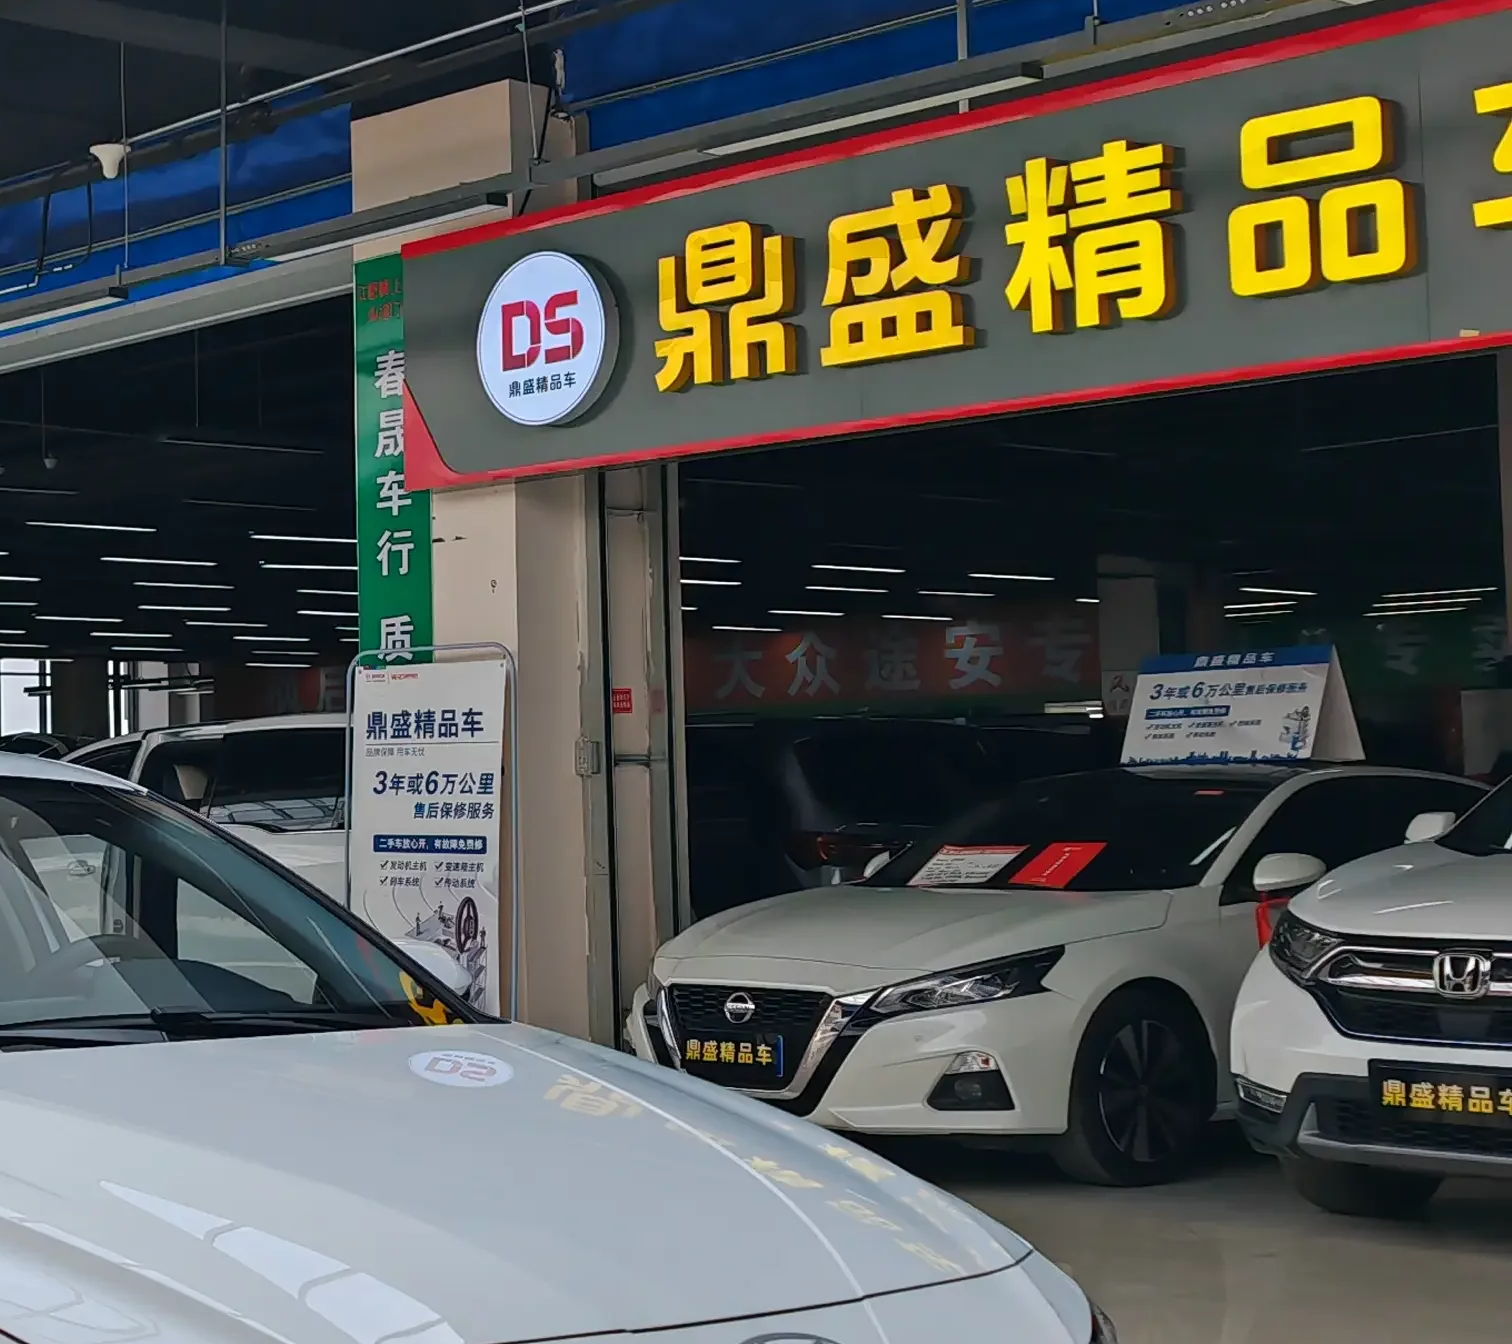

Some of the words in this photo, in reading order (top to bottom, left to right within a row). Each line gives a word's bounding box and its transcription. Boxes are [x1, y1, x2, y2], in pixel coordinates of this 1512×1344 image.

[655, 80, 1512, 395] 鼎盛精品
[501, 289, 584, 372] DS
[508, 370, 577, 399] 鼎盛精品车
[374, 348, 415, 577] 春晟车行
[366, 707, 485, 741] 鼎盛精品车
[372, 769, 495, 796] 3年或6万公里
[413, 801, 496, 820] 售后保修服务
[685, 1038, 773, 1066] 鼎盛精品车
